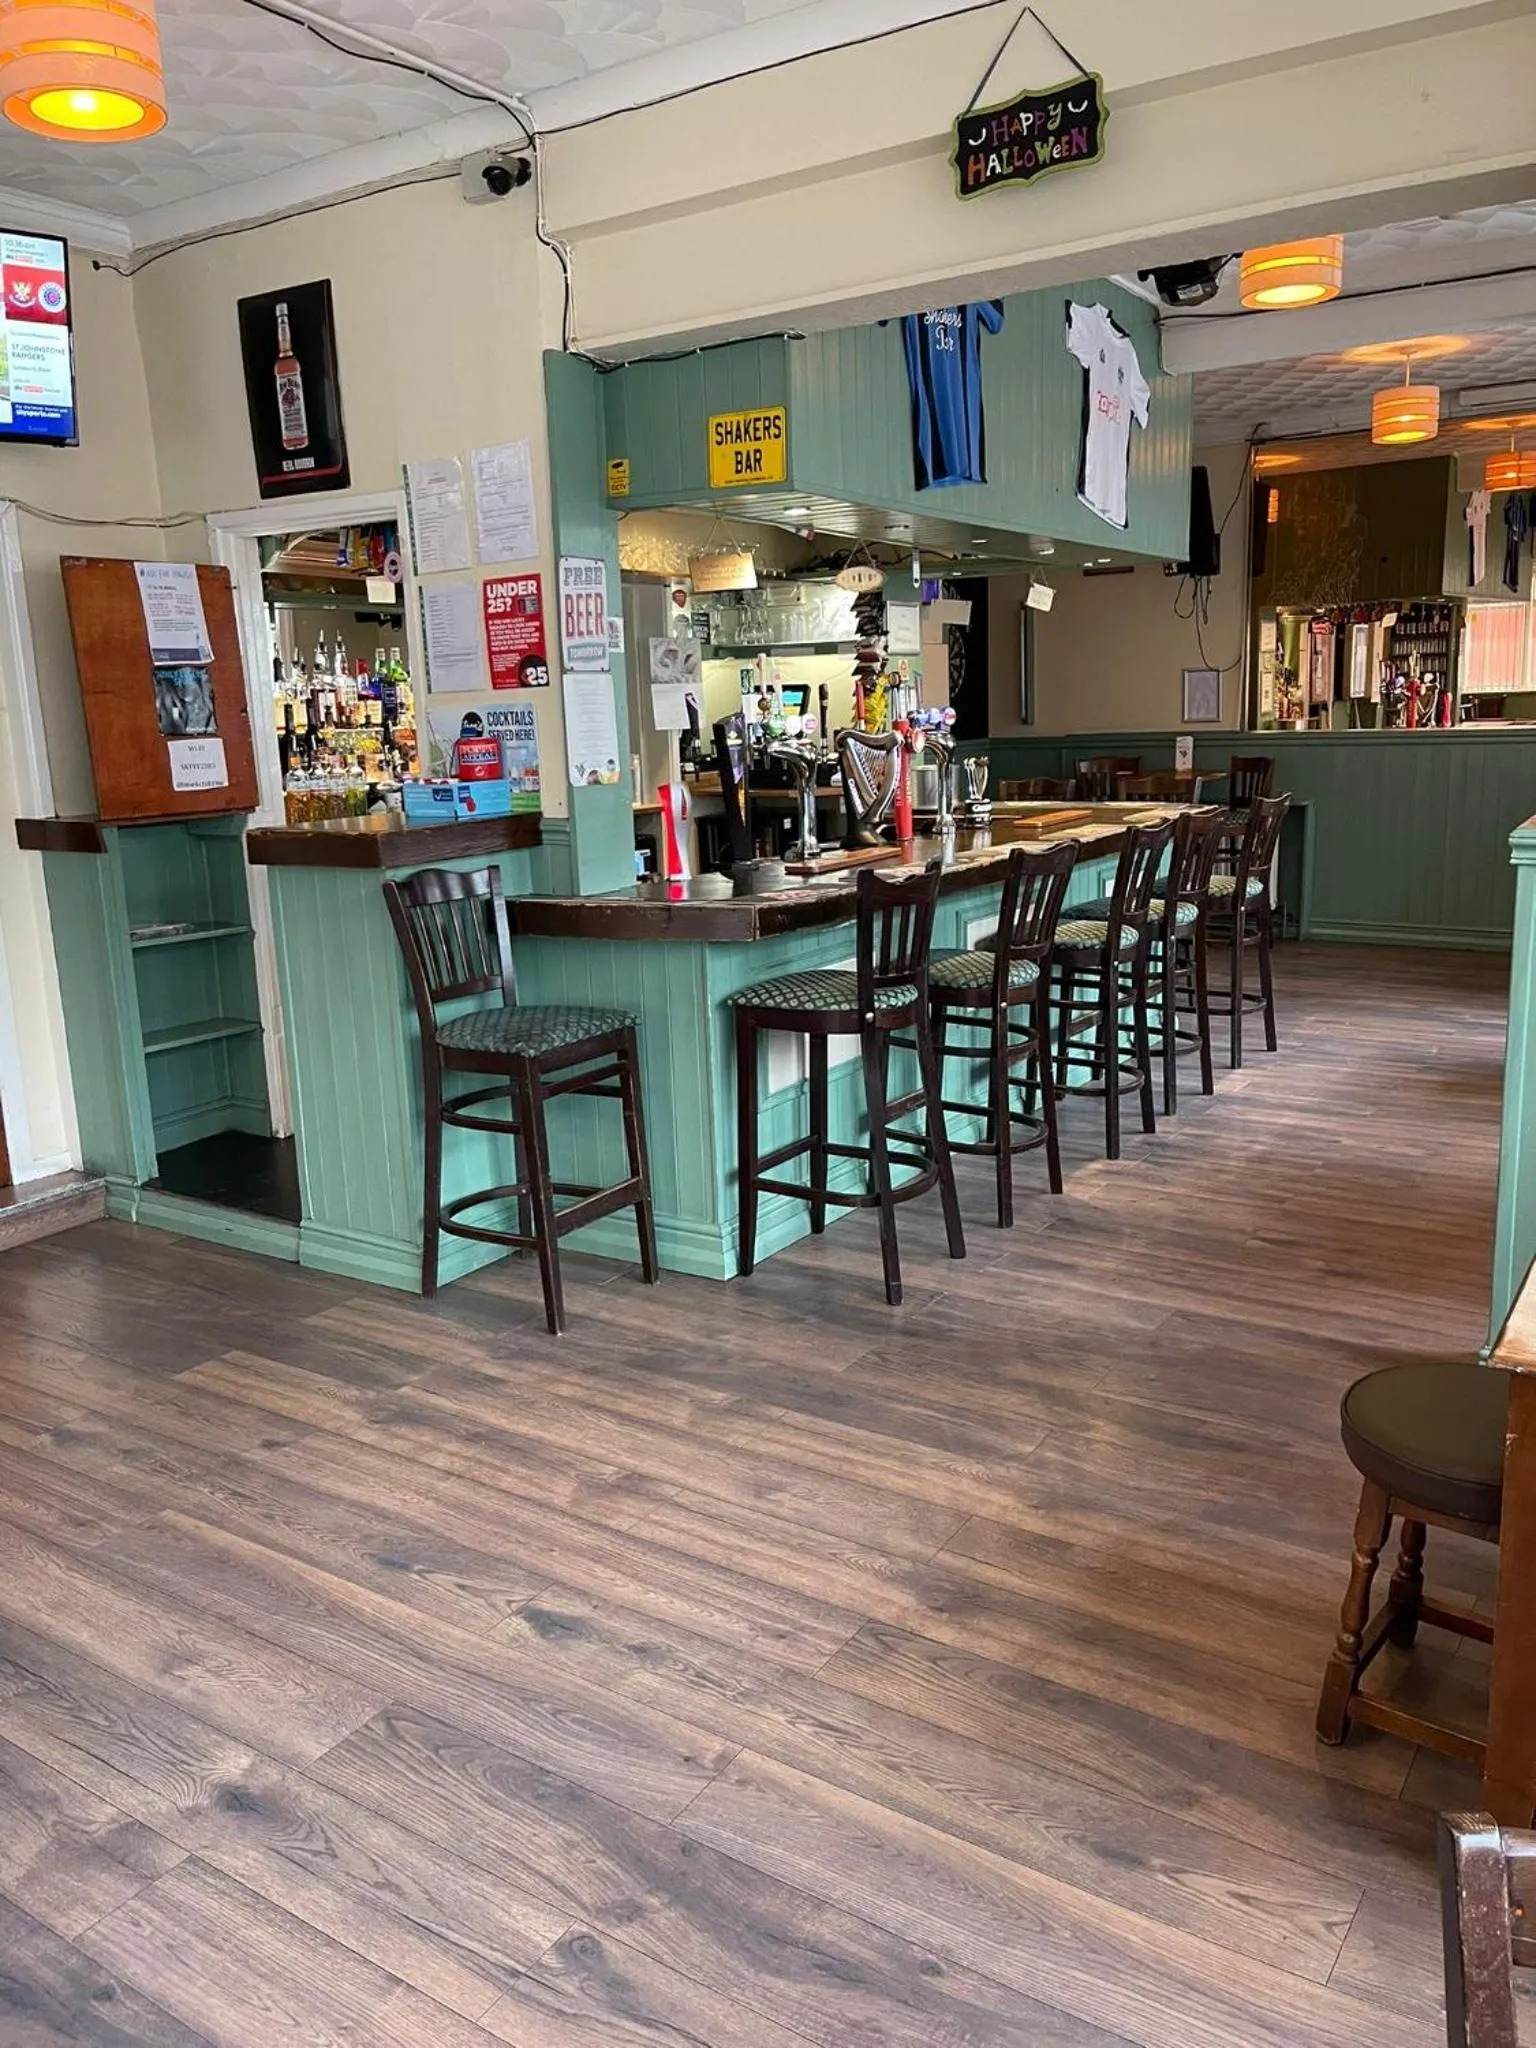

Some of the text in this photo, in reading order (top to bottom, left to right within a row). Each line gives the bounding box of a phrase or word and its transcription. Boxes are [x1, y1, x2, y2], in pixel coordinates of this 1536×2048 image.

[715, 415, 782, 446] SHAKERS
[734, 449, 763, 474] BAR
[563, 566, 603, 587] FREE
[486, 579, 538, 599] UNDER
[487, 597, 512, 614] 25?
[564, 592, 604, 638] BEER
[525, 666, 548, 686] 25
[486, 711, 534, 726] COCKTAILS
[488, 730, 514, 741] SERVED
